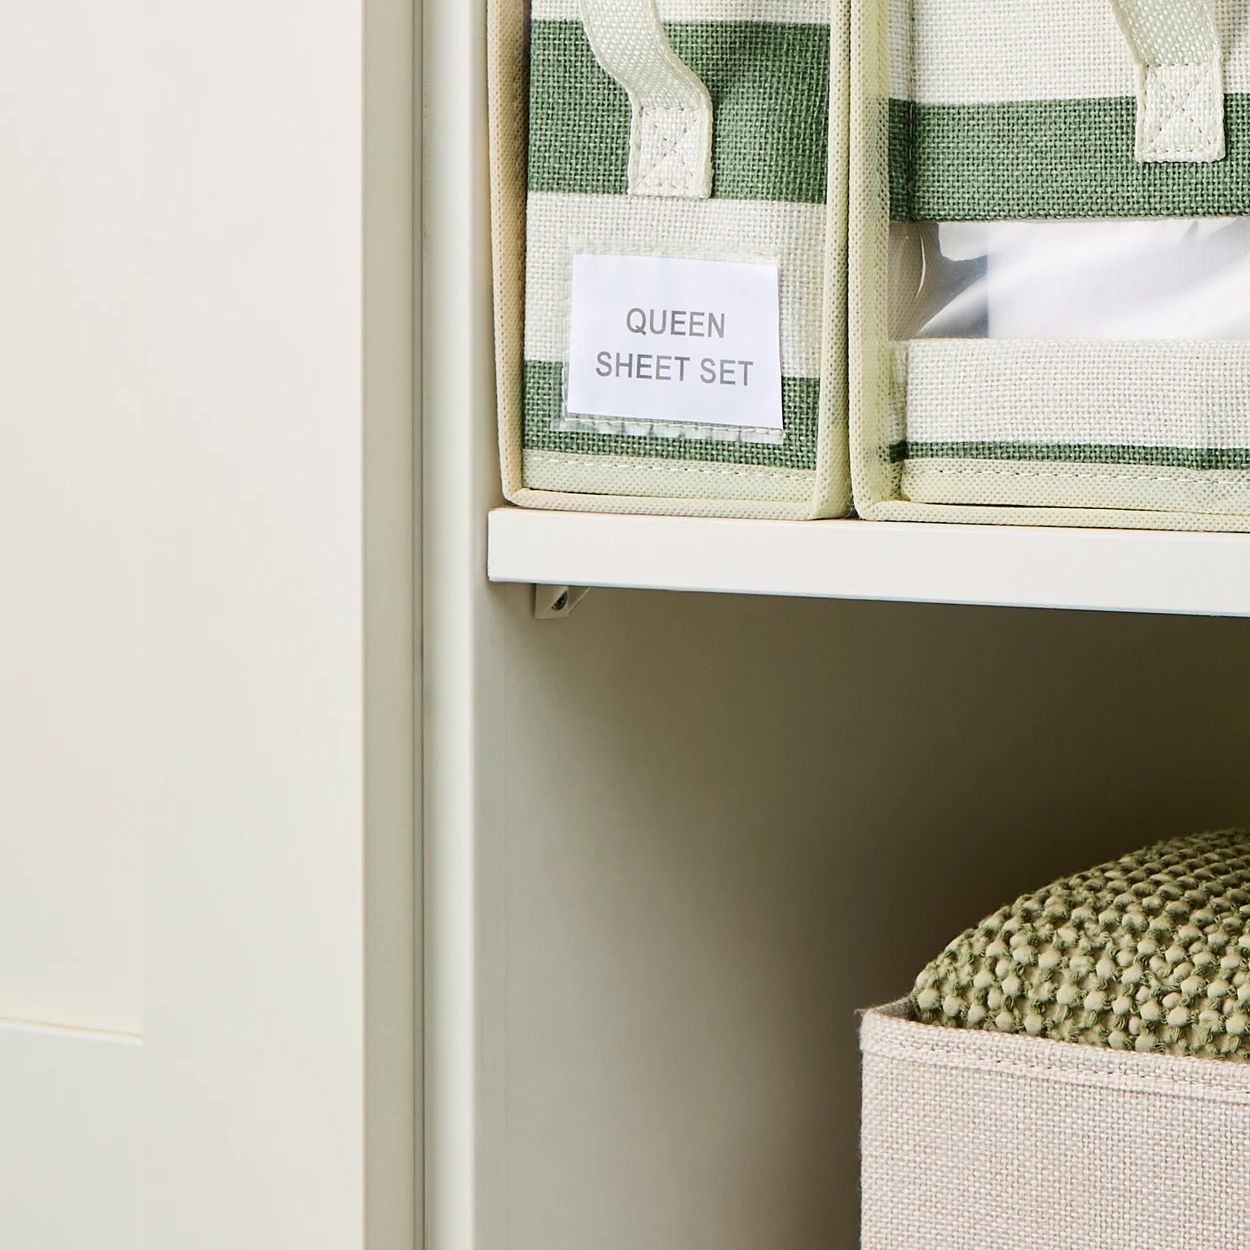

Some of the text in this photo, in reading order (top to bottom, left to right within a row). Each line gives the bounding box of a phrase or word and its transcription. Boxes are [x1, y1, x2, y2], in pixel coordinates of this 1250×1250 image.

[626, 307, 725, 338] QUEEN
[595, 351, 754, 386] SHEET SET
